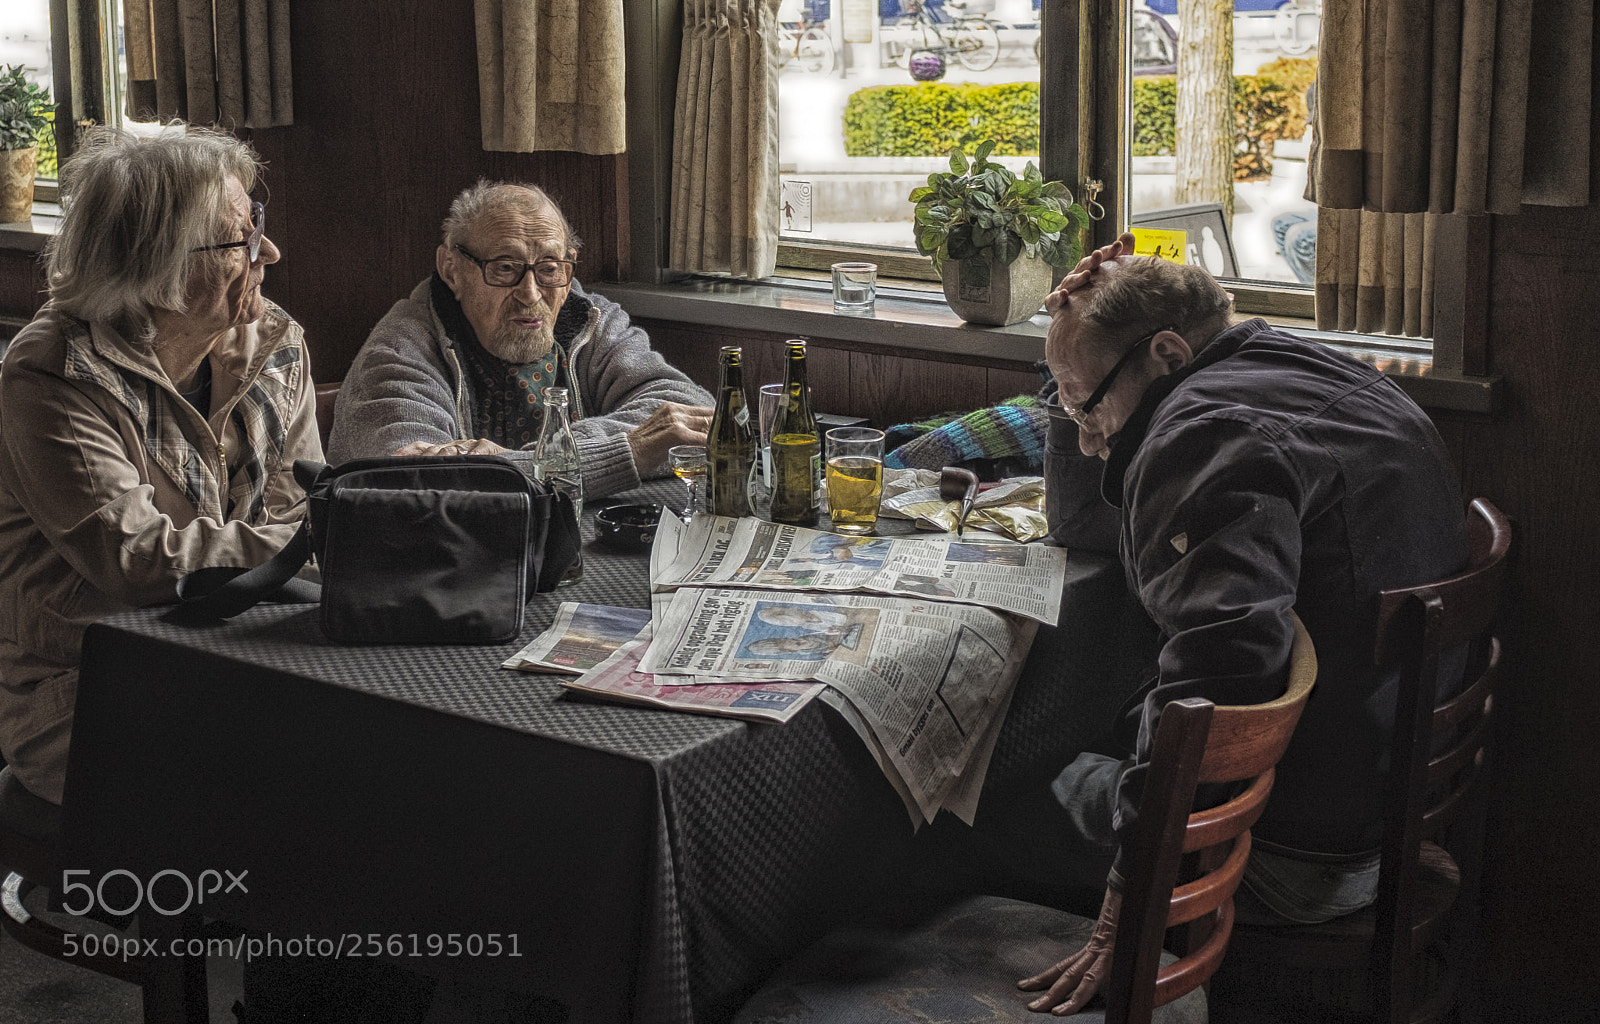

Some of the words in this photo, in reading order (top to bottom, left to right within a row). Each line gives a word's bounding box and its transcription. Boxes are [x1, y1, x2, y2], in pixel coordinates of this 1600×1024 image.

[899, 734, 915, 757] Gmail
[912, 711, 929, 737] bygges
[926, 698, 935, 712] om
